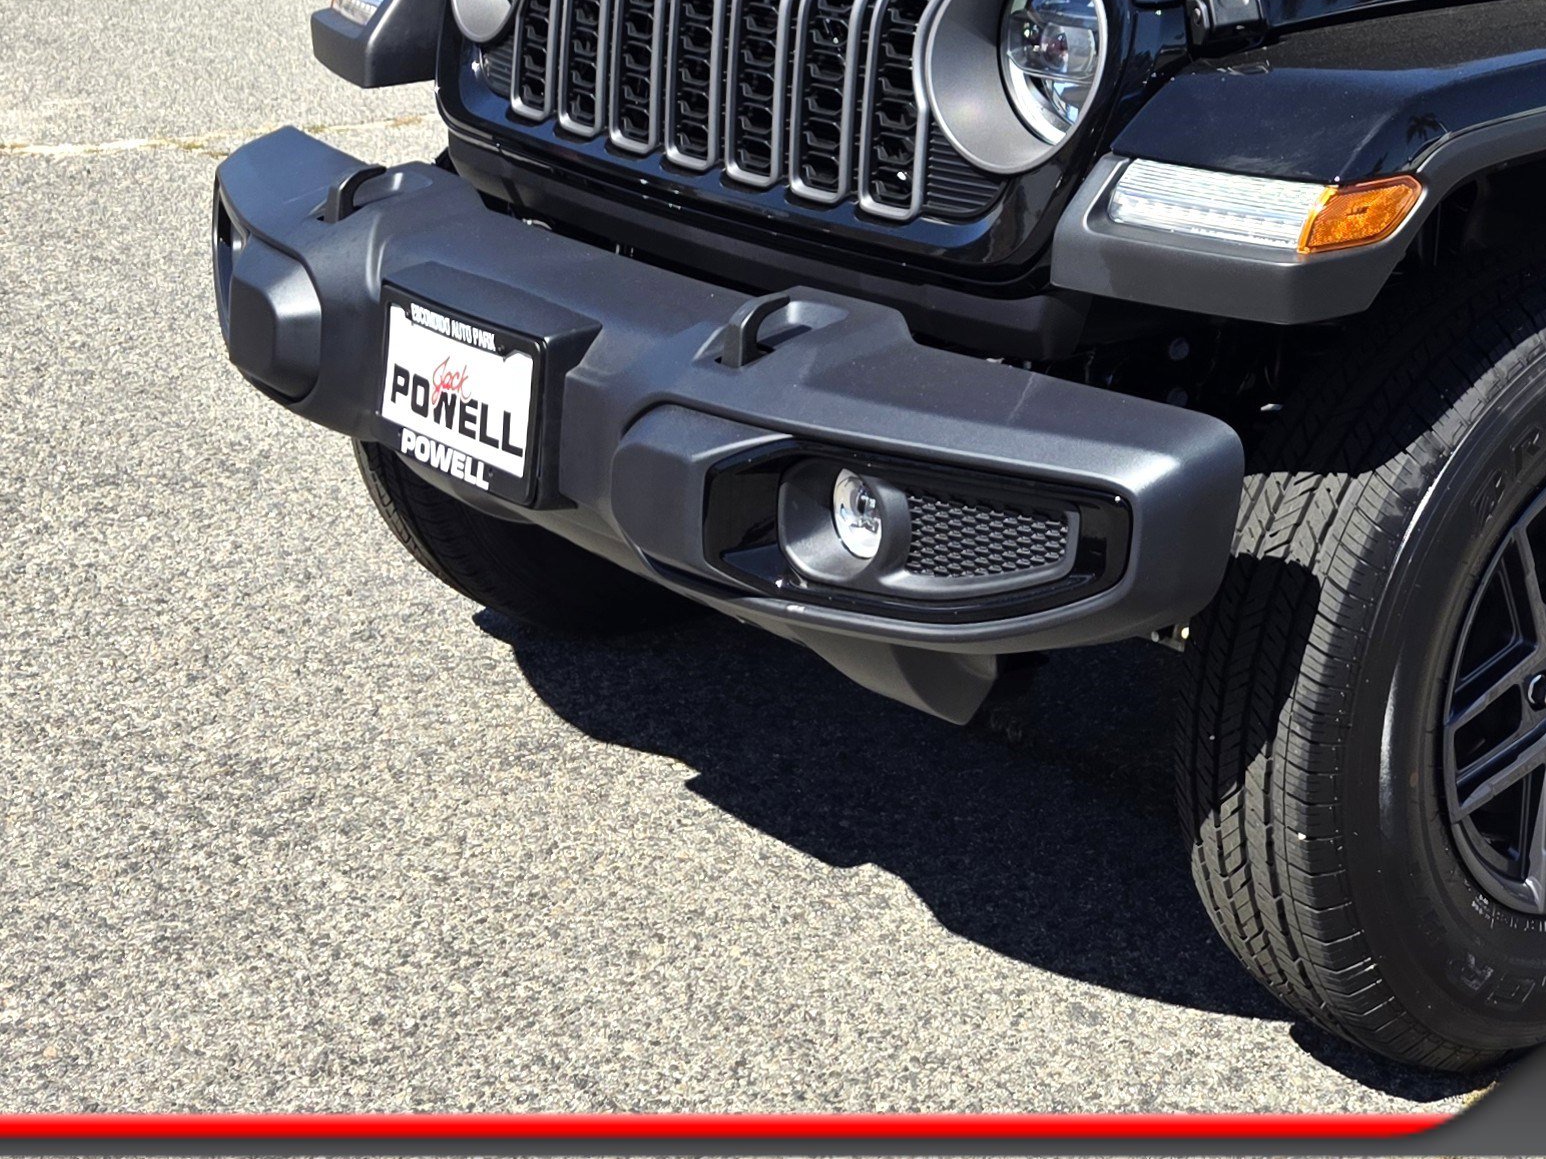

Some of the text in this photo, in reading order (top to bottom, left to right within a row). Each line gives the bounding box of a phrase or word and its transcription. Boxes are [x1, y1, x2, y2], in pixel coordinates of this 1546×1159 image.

[390, 363, 523, 457] POWELL
[431, 356, 471, 405] Jack
[401, 427, 489, 490] POWELL
